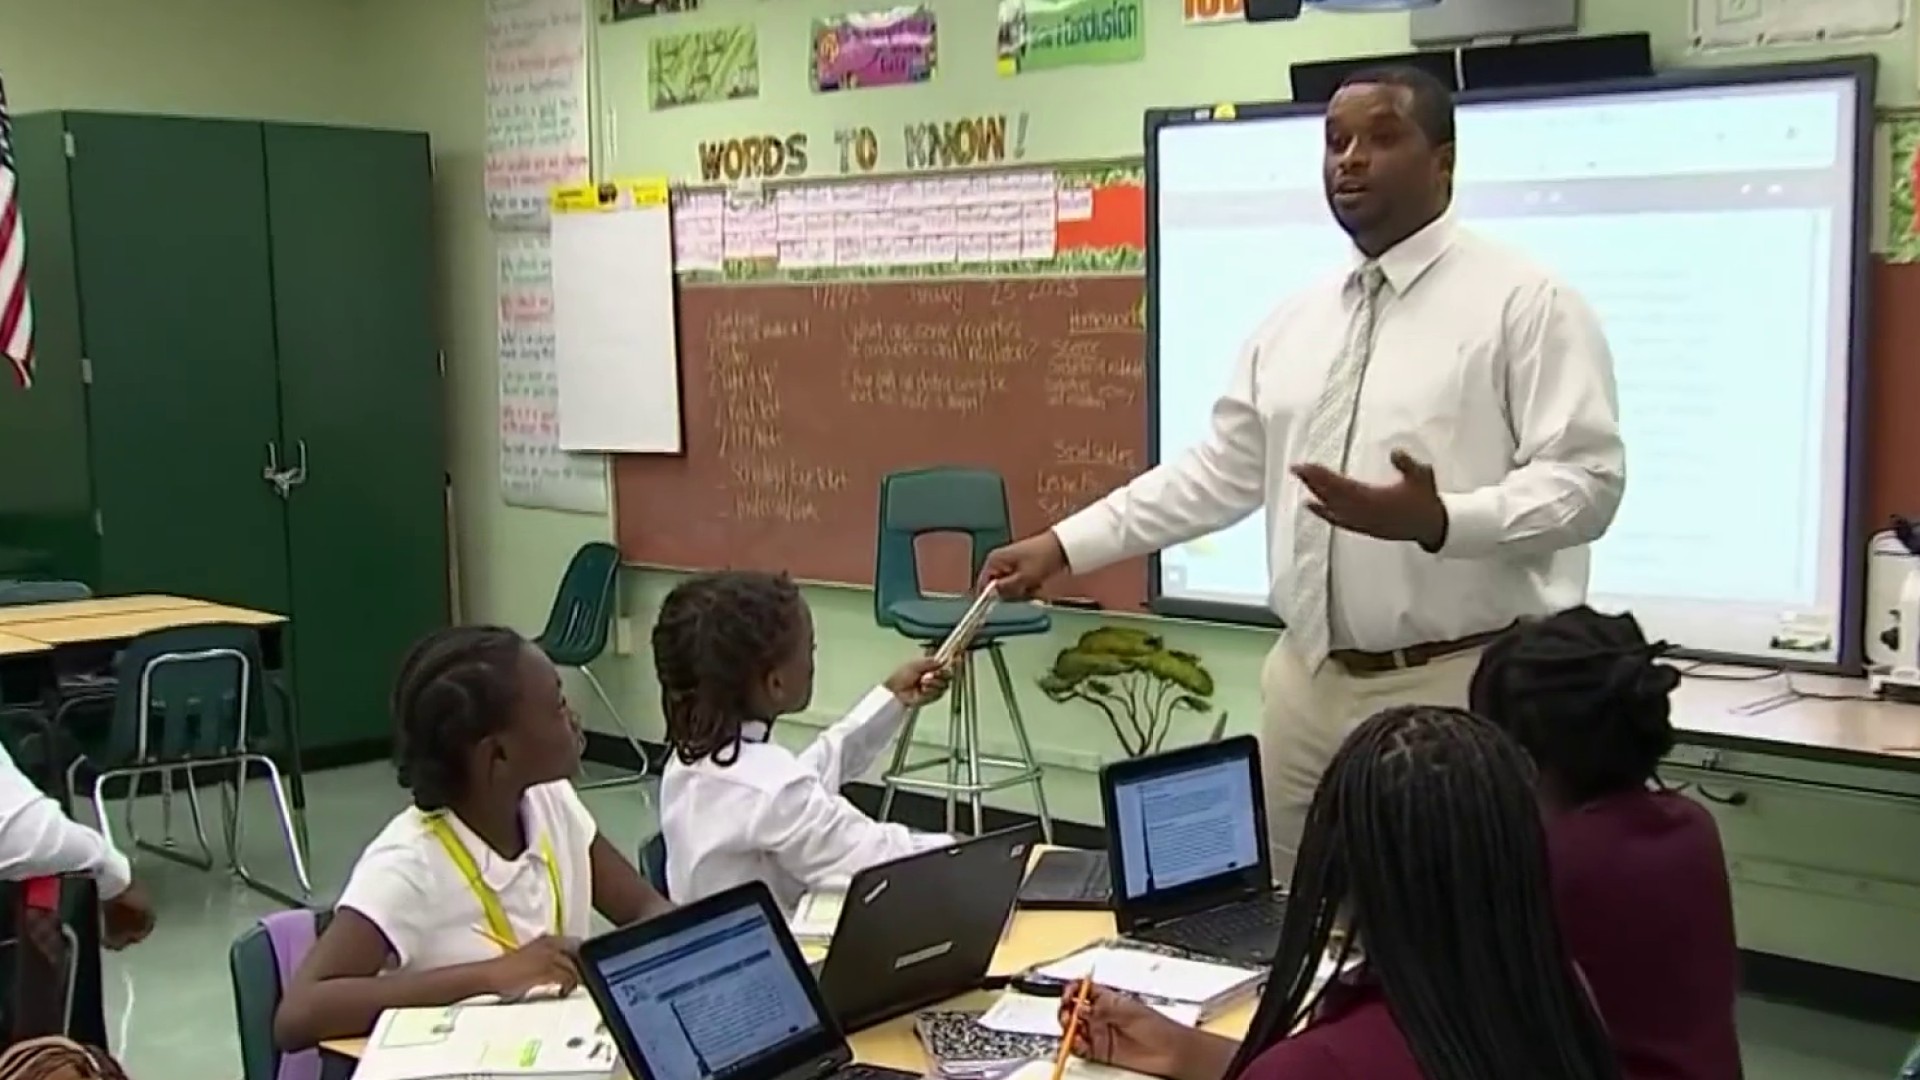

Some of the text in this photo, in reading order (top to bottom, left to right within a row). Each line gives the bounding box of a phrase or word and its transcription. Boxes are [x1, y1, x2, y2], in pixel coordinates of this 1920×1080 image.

[1064, 2, 1138, 45] Conclusion
[699, 133, 807, 179] WORDS
[834, 126, 878, 173] TO
